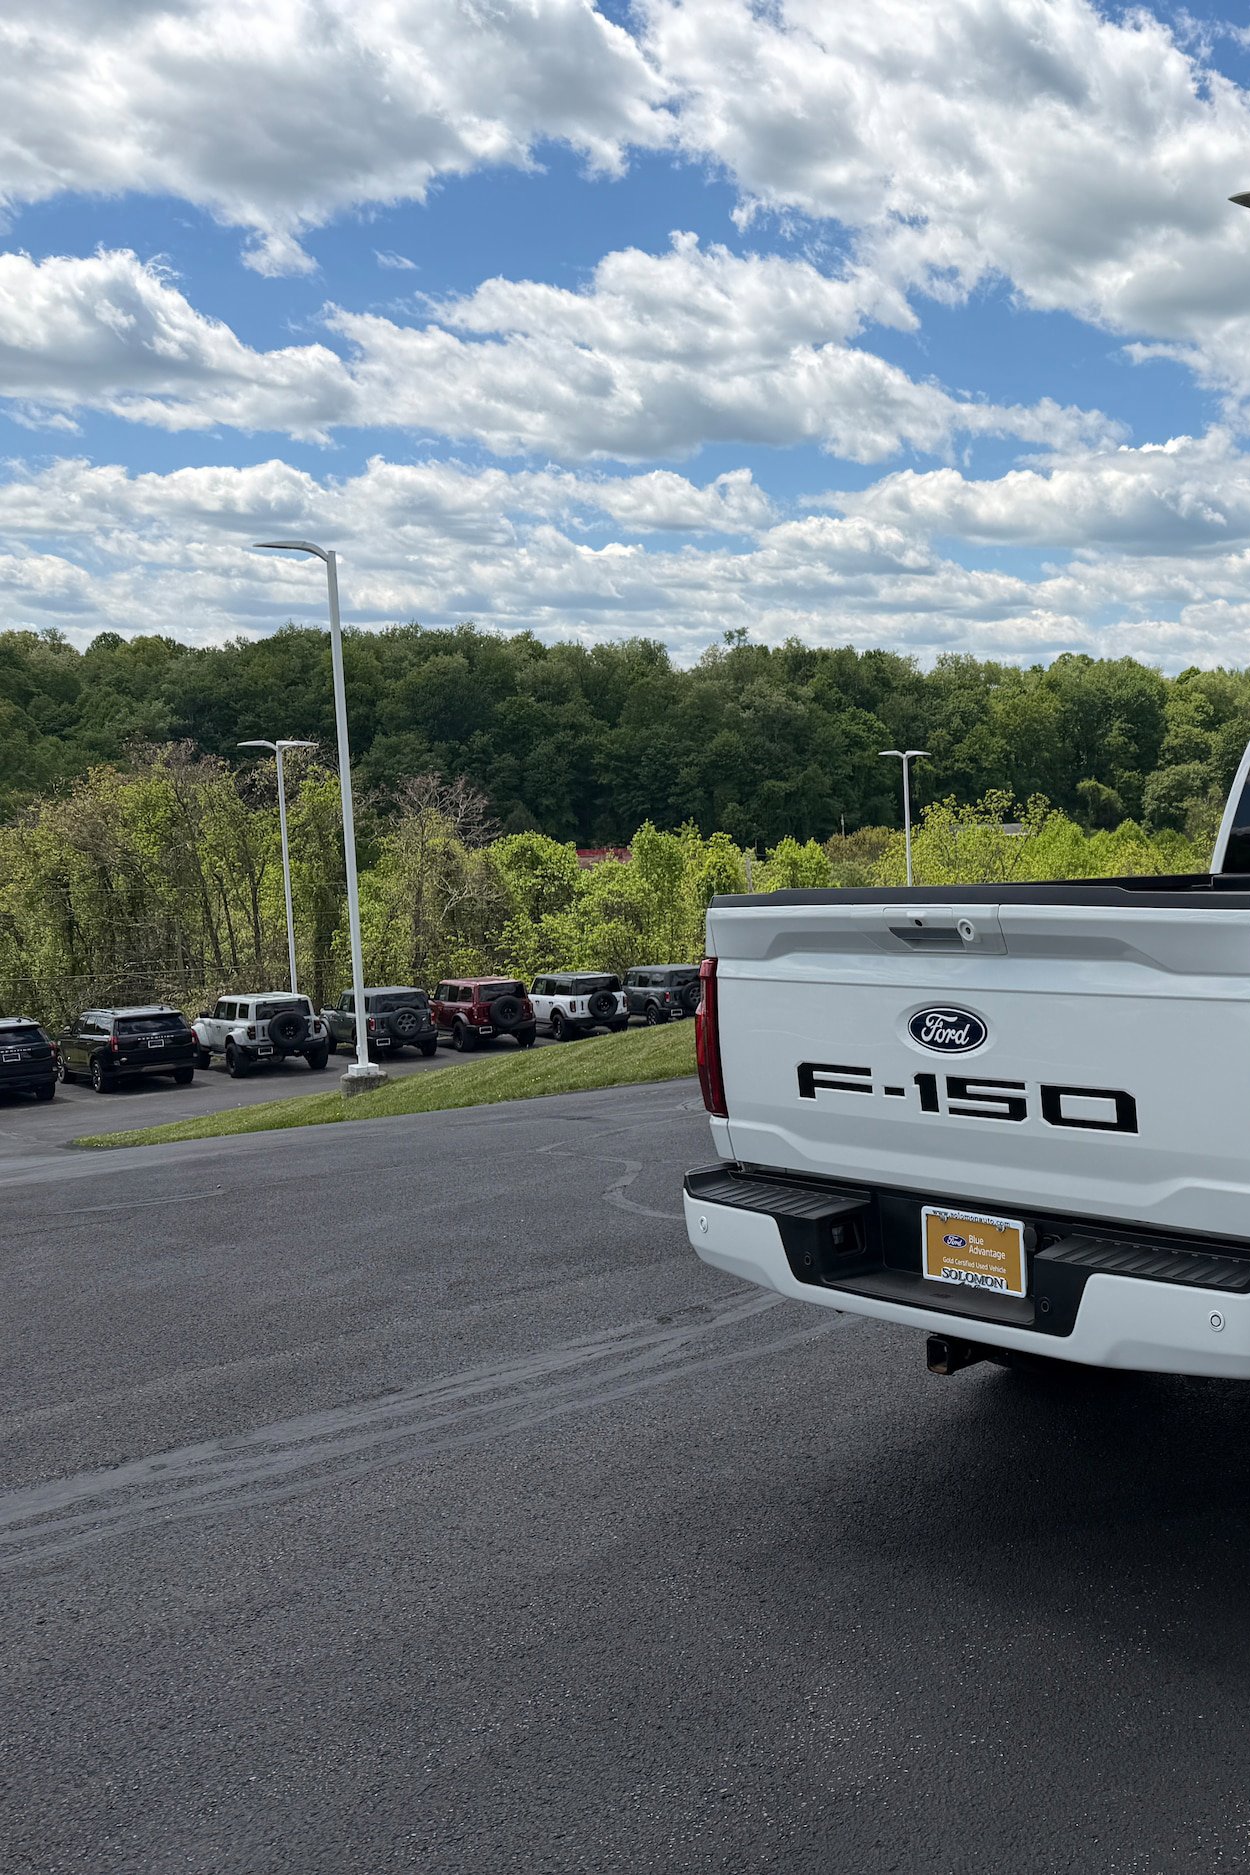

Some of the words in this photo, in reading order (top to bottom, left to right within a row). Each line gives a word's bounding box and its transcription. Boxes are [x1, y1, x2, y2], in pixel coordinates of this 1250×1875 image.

[921, 1013, 971, 1046] Ford
[797, 1062, 1139, 1135] F-150
[945, 1234, 963, 1248] Ford
[968, 1234, 984, 1245] Blue
[968, 1245, 1006, 1260] Advantage
[942, 1256, 954, 1264] Gold
[954, 1258, 975, 1268] Certified
[975, 1262, 988, 1270] Used
[989, 1264, 1007, 1274] Vehicle
[942, 1267, 1004, 1289] SOLOMON
